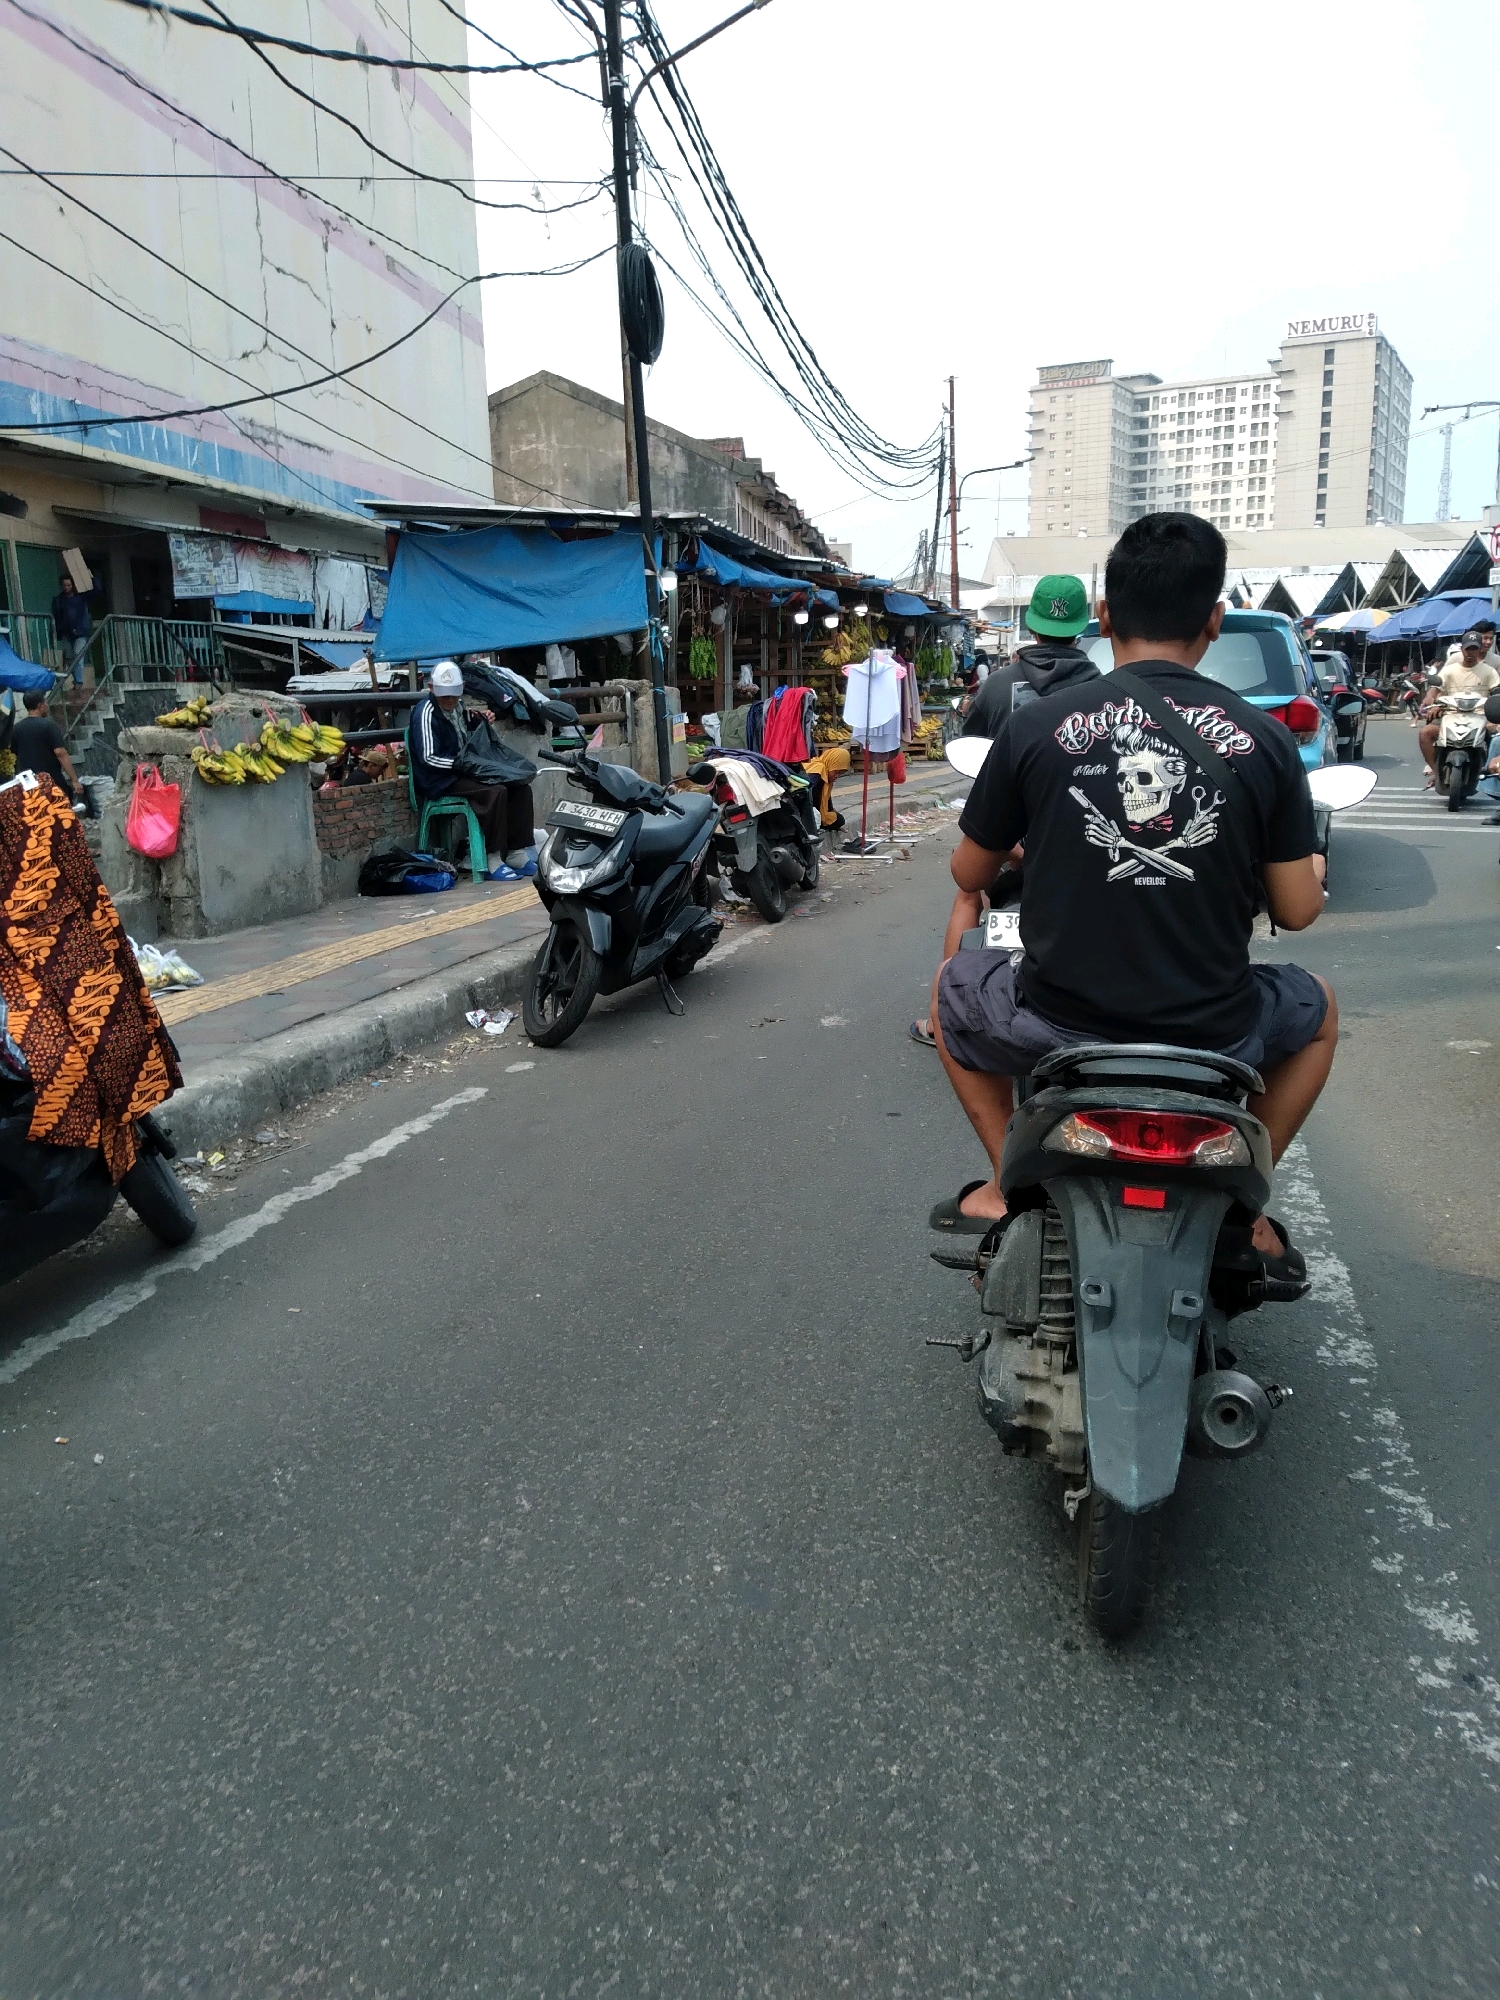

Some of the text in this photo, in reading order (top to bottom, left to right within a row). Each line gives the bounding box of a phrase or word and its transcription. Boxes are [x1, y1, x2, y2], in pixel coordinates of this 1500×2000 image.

[1287, 314, 1364, 336] NEMURU
[1039, 360, 1108, 381] Bailey's City
[1049, 597, 1069, 617] NY
[1056, 697, 1254, 757] Barbshop
[1073, 764, 1109, 777] Mister
[558, 803, 623, 824] B 3430 WFH
[1134, 877, 1167, 886] NEVERLOSE
[990, 914, 999, 929] B
